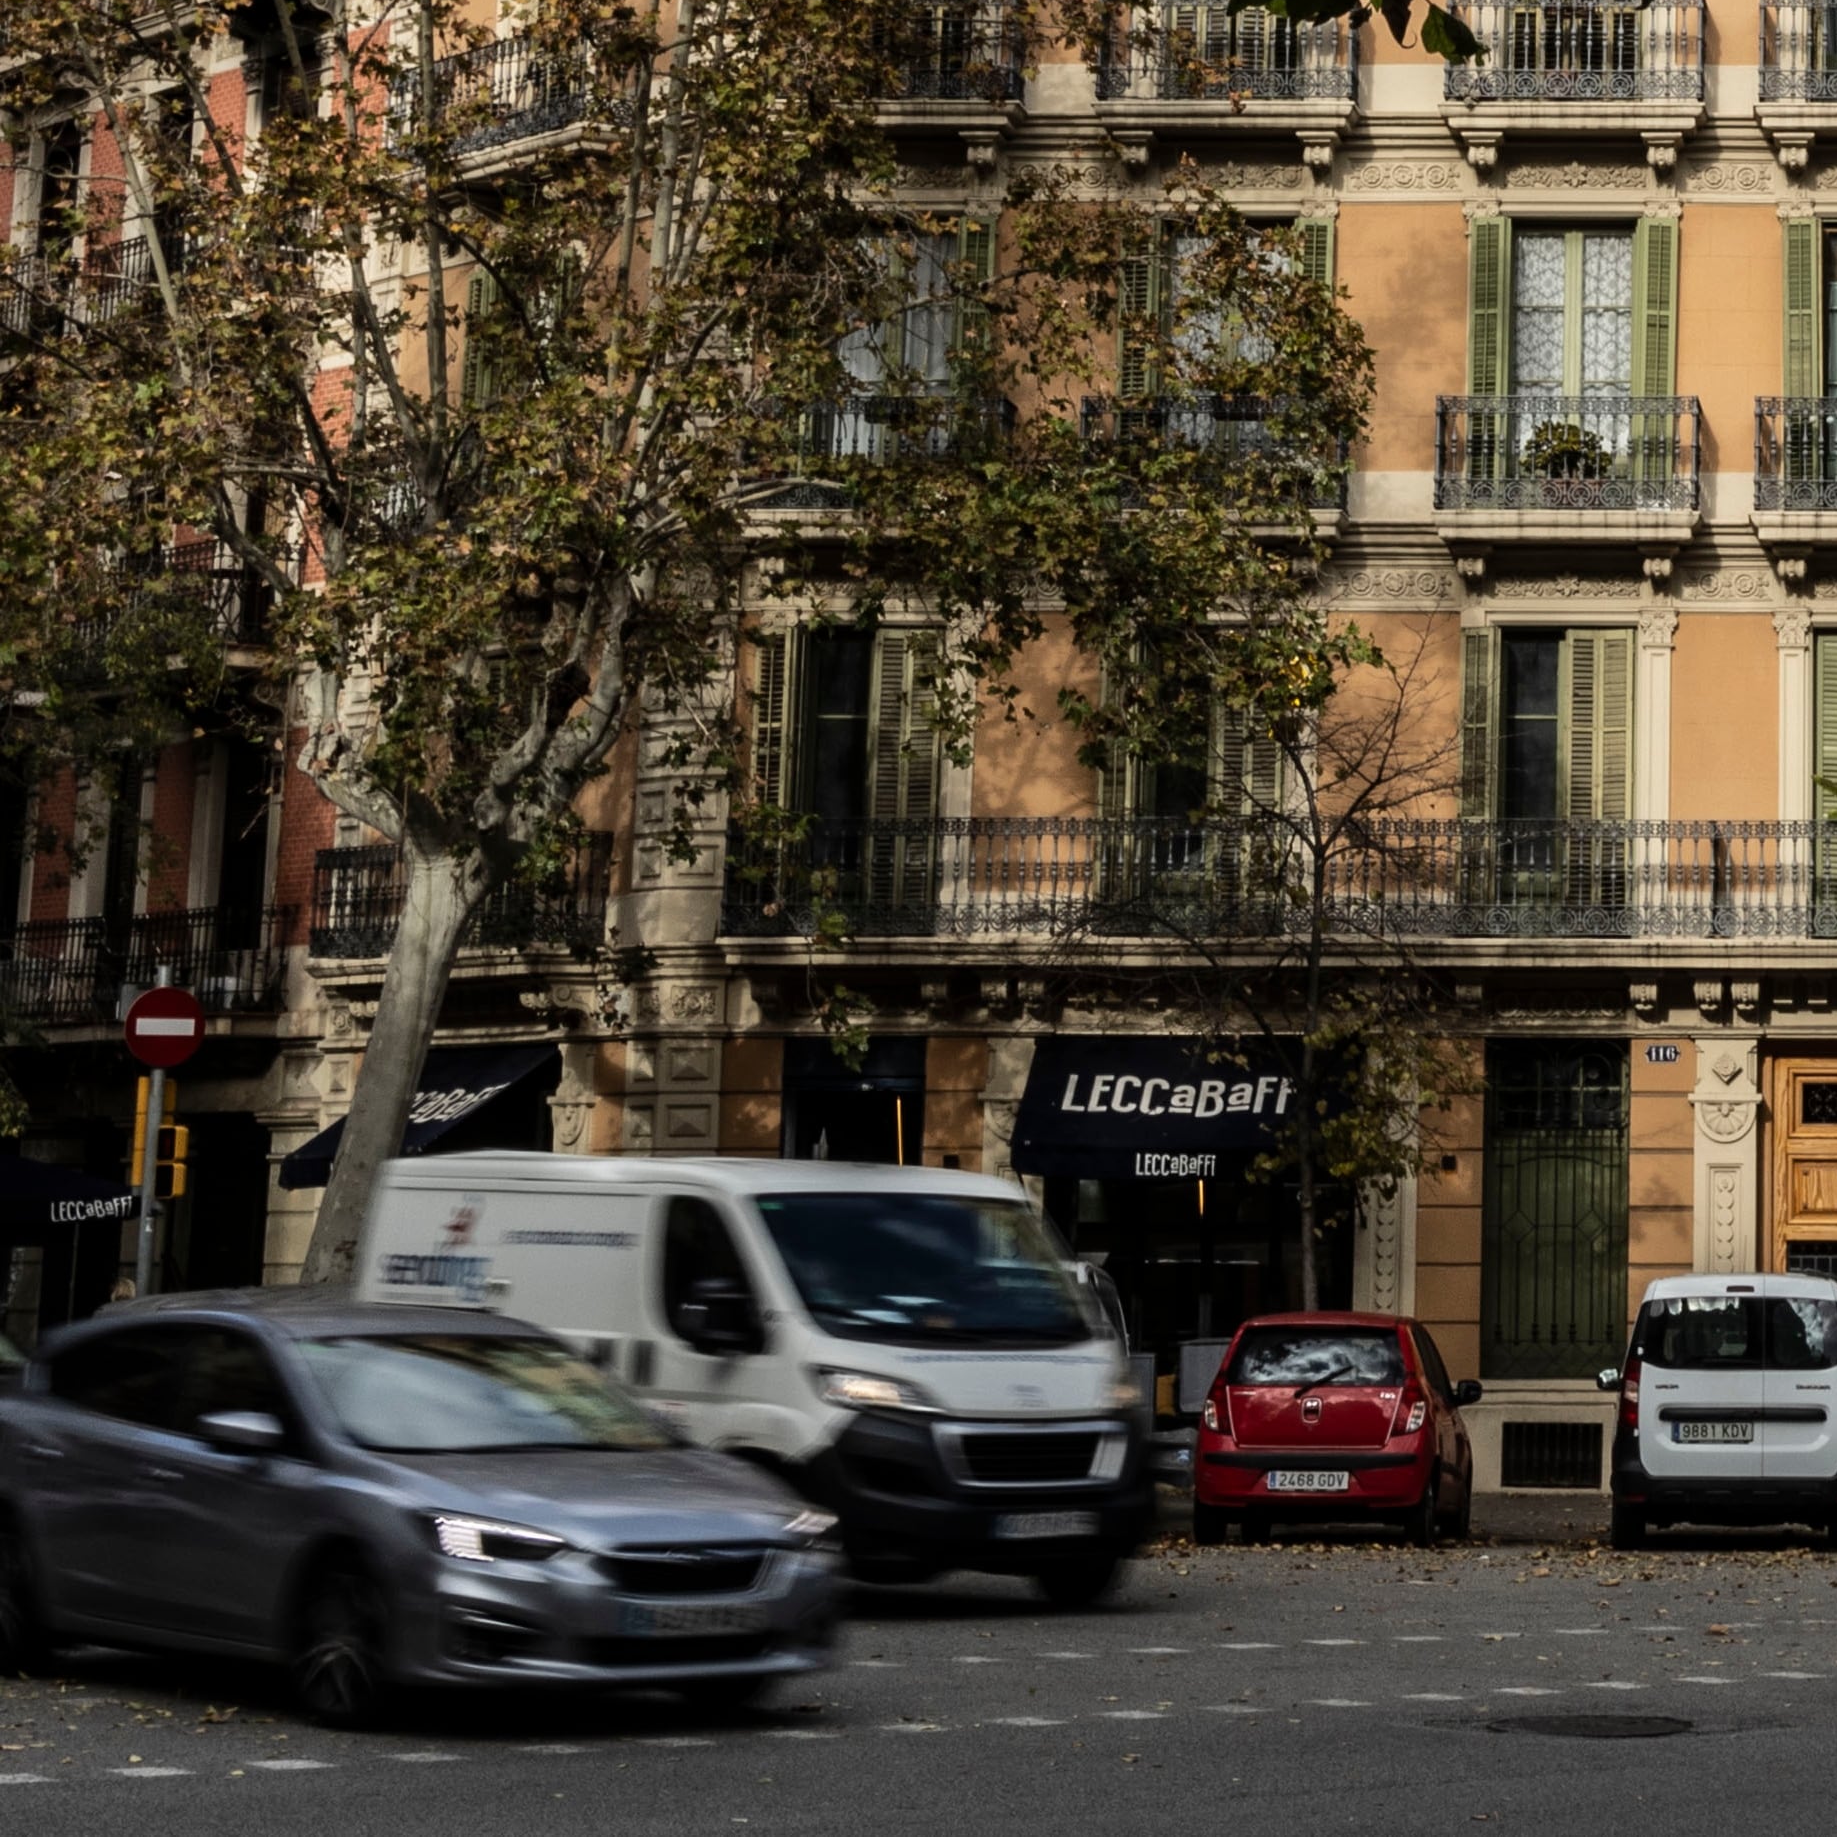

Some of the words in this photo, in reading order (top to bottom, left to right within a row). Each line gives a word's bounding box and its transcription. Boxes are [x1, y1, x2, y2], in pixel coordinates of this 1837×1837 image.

[1651, 1047, 1676, 1061] 116
[1682, 1425, 1716, 1438] 9881
[1722, 1425, 1749, 1438] KDV
[1279, 1473, 1314, 1488] 2468
[1318, 1473, 1345, 1488] GDV
